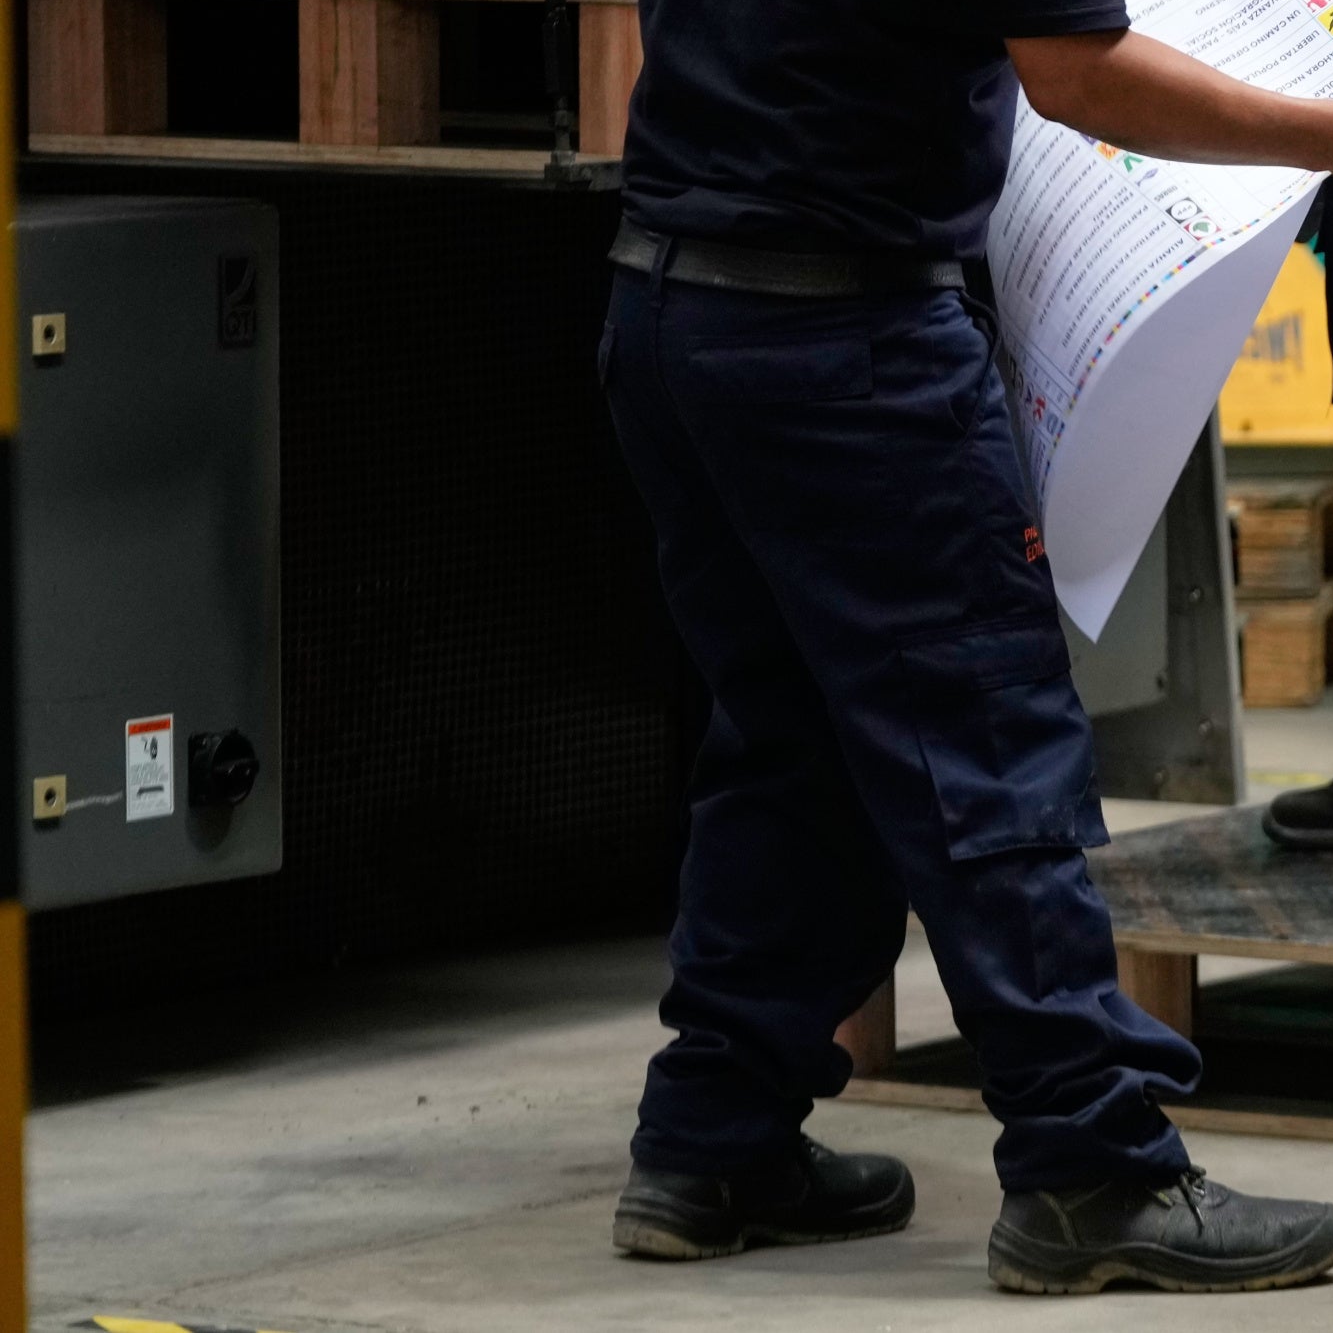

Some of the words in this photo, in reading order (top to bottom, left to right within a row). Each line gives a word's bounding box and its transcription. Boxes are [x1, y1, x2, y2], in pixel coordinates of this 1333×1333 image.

[1186, 26, 1219, 46] SOCIAL
[1249, 19, 1287, 47] CAMINO
[1278, 29, 1320, 61] LIBERTAD
